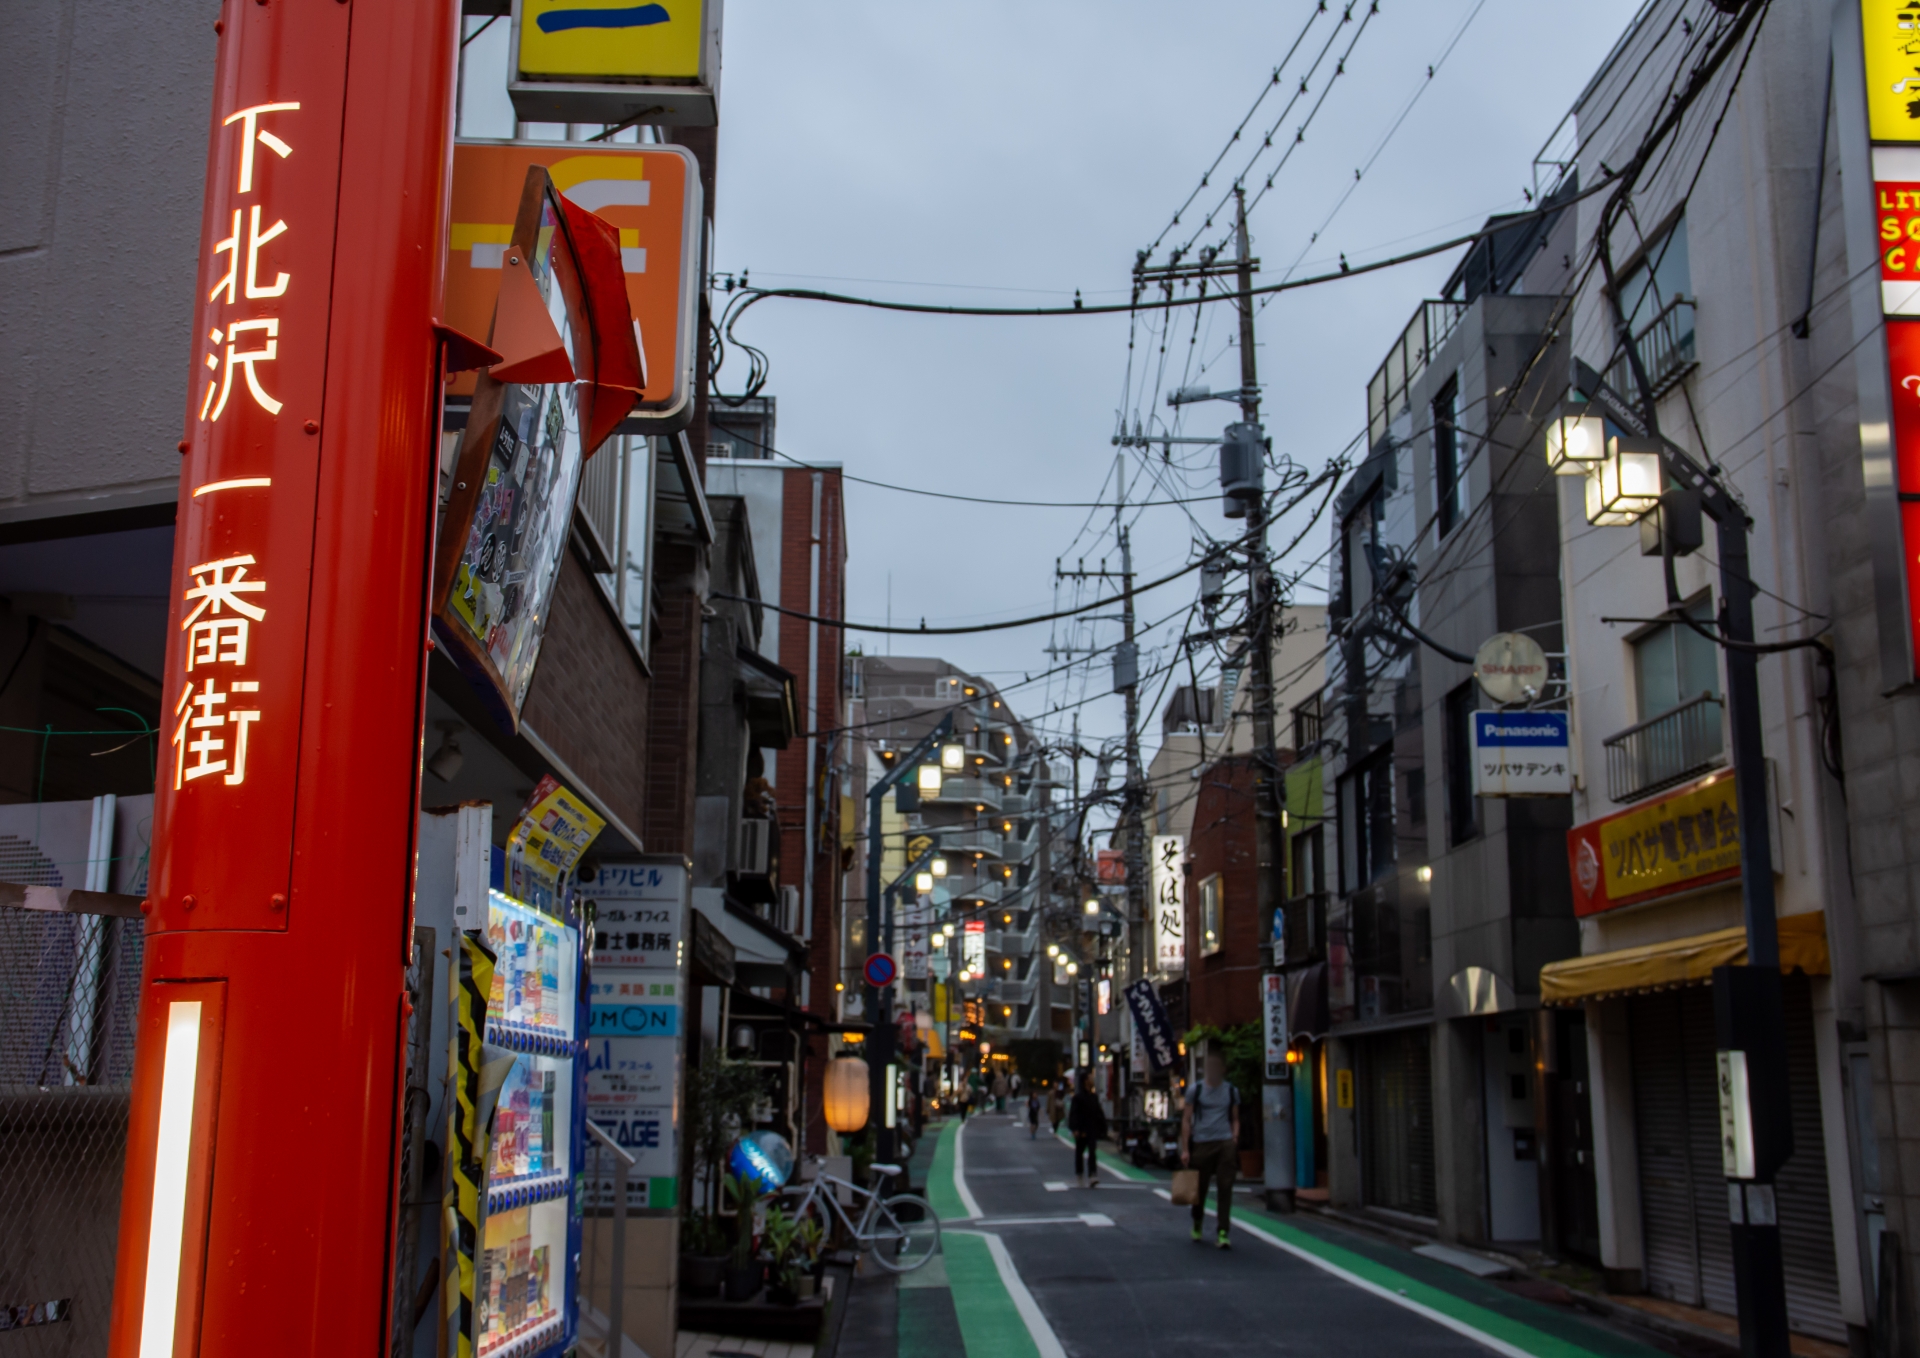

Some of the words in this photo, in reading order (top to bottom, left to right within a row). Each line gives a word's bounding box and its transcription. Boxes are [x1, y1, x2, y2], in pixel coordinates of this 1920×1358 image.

[173, 101, 301, 790] 下北沢一番街
[1482, 664, 1542, 675] SHARP
[1484, 724, 1560, 737] Panasonic
[1484, 762, 1567, 777] ツバサデンキ
[649, 984, 675, 997] 国語
